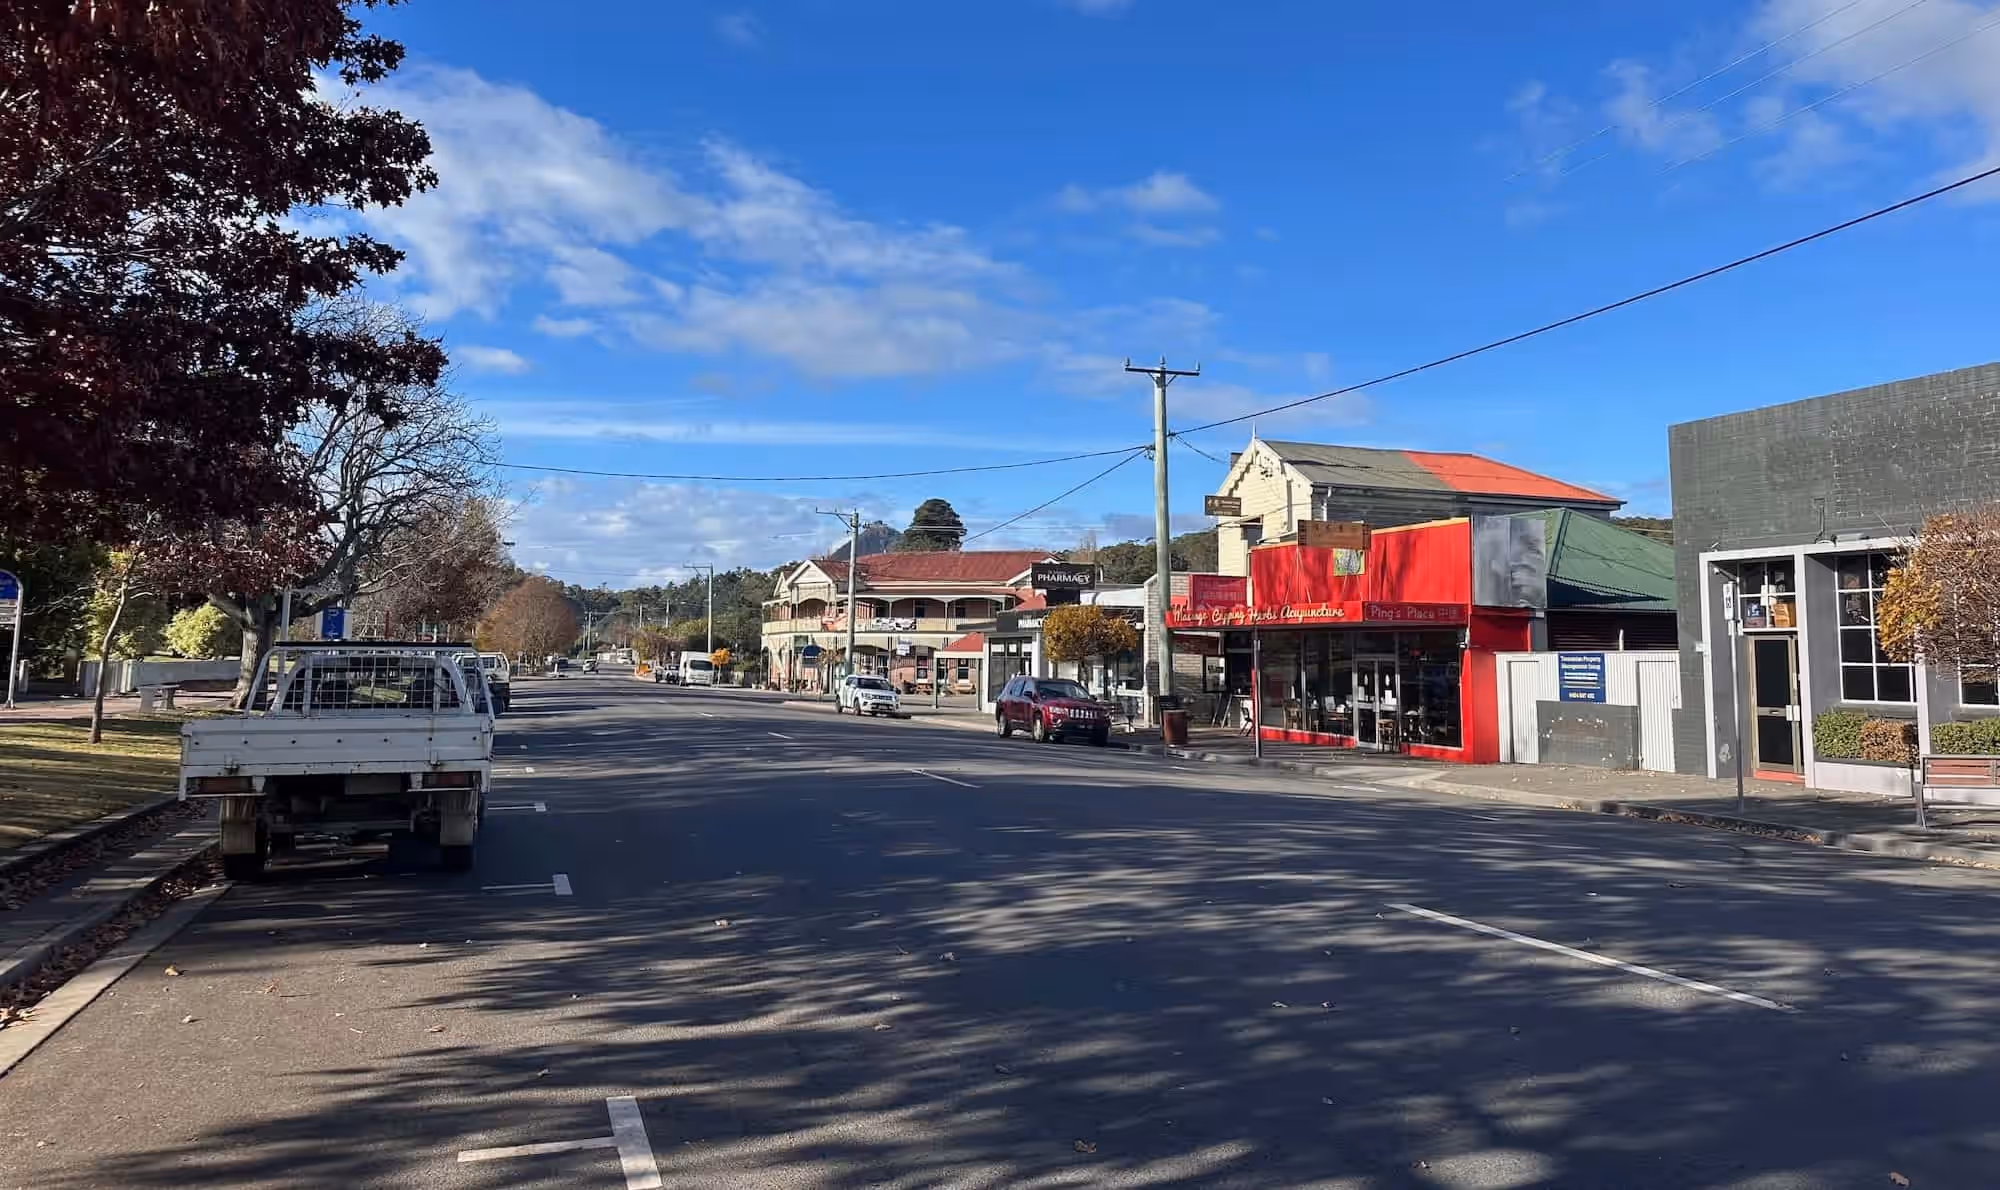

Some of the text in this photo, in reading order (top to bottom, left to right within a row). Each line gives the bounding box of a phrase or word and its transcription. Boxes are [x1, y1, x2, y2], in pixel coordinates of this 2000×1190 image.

[1037, 573, 1090, 583] PHARMACY
[1172, 604, 1208, 625] Massage
[1248, 606, 1277, 621] Herbs
[1280, 603, 1345, 624] Acupuncture
[1370, 605, 1435, 620] Ping's Place
